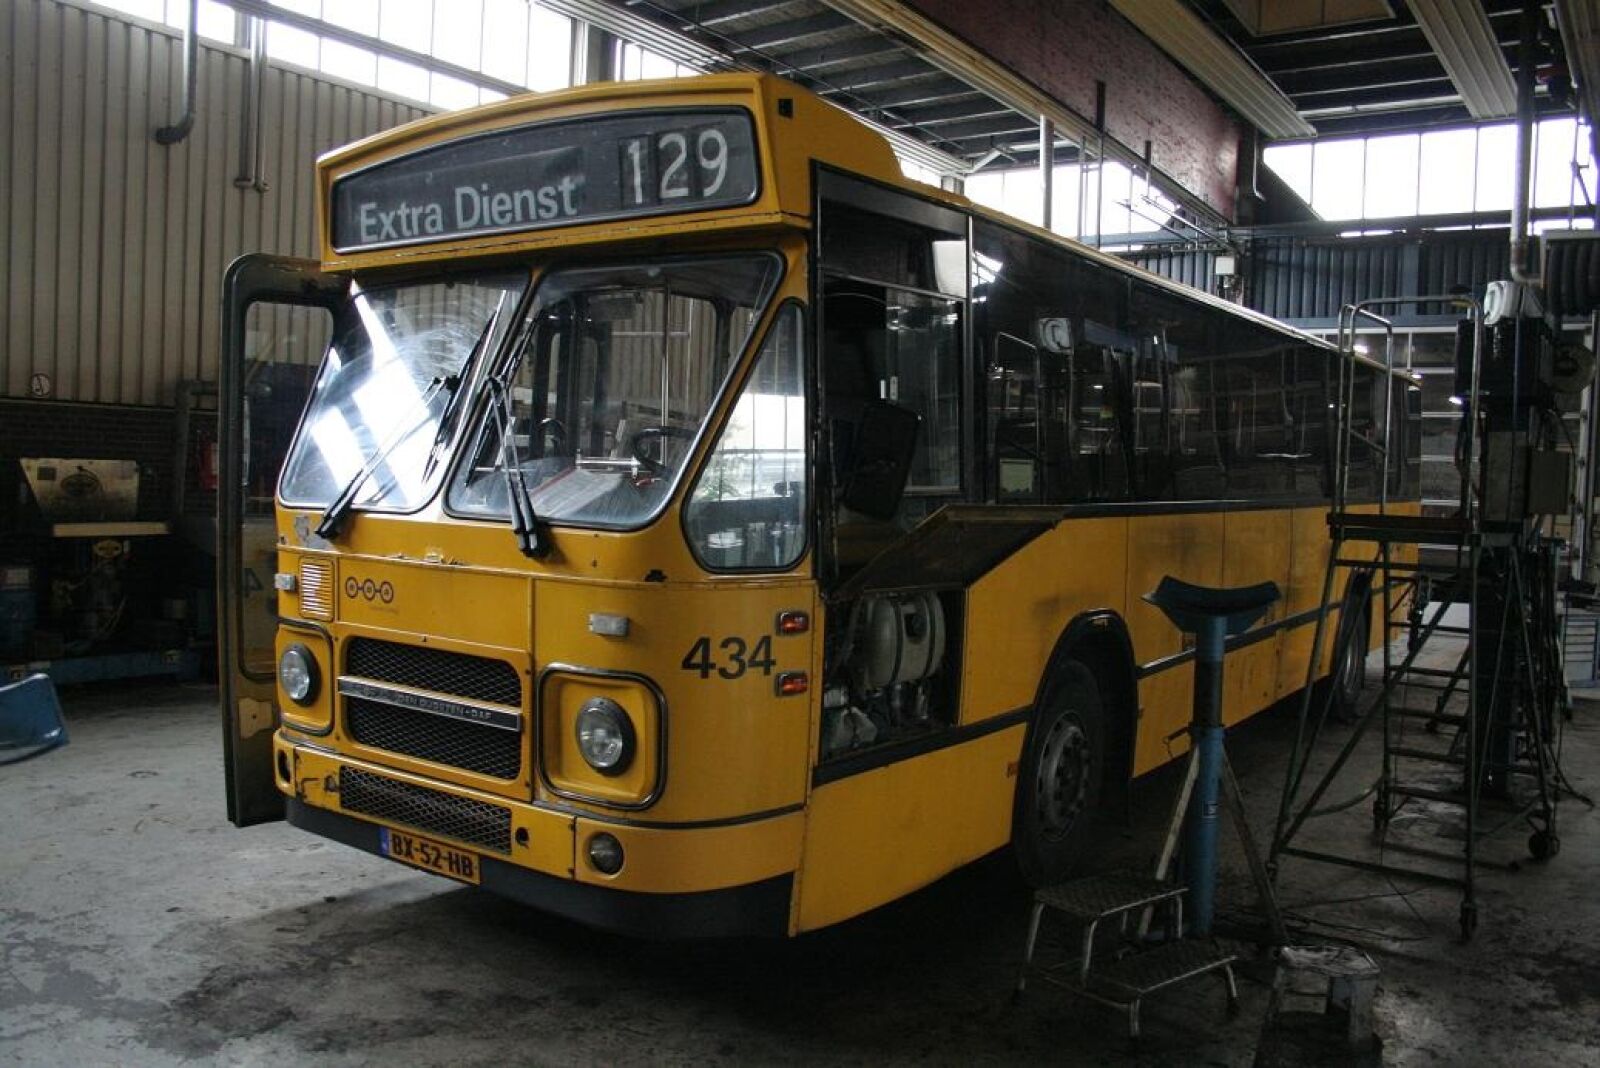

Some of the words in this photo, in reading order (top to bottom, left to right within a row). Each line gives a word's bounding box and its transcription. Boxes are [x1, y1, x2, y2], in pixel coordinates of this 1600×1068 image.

[359, 201, 444, 243] Extra
[454, 175, 580, 230] Dienst
[624, 128, 729, 205] 129
[681, 635, 777, 680] 434
[390, 832, 474, 877] BX-52-HB
